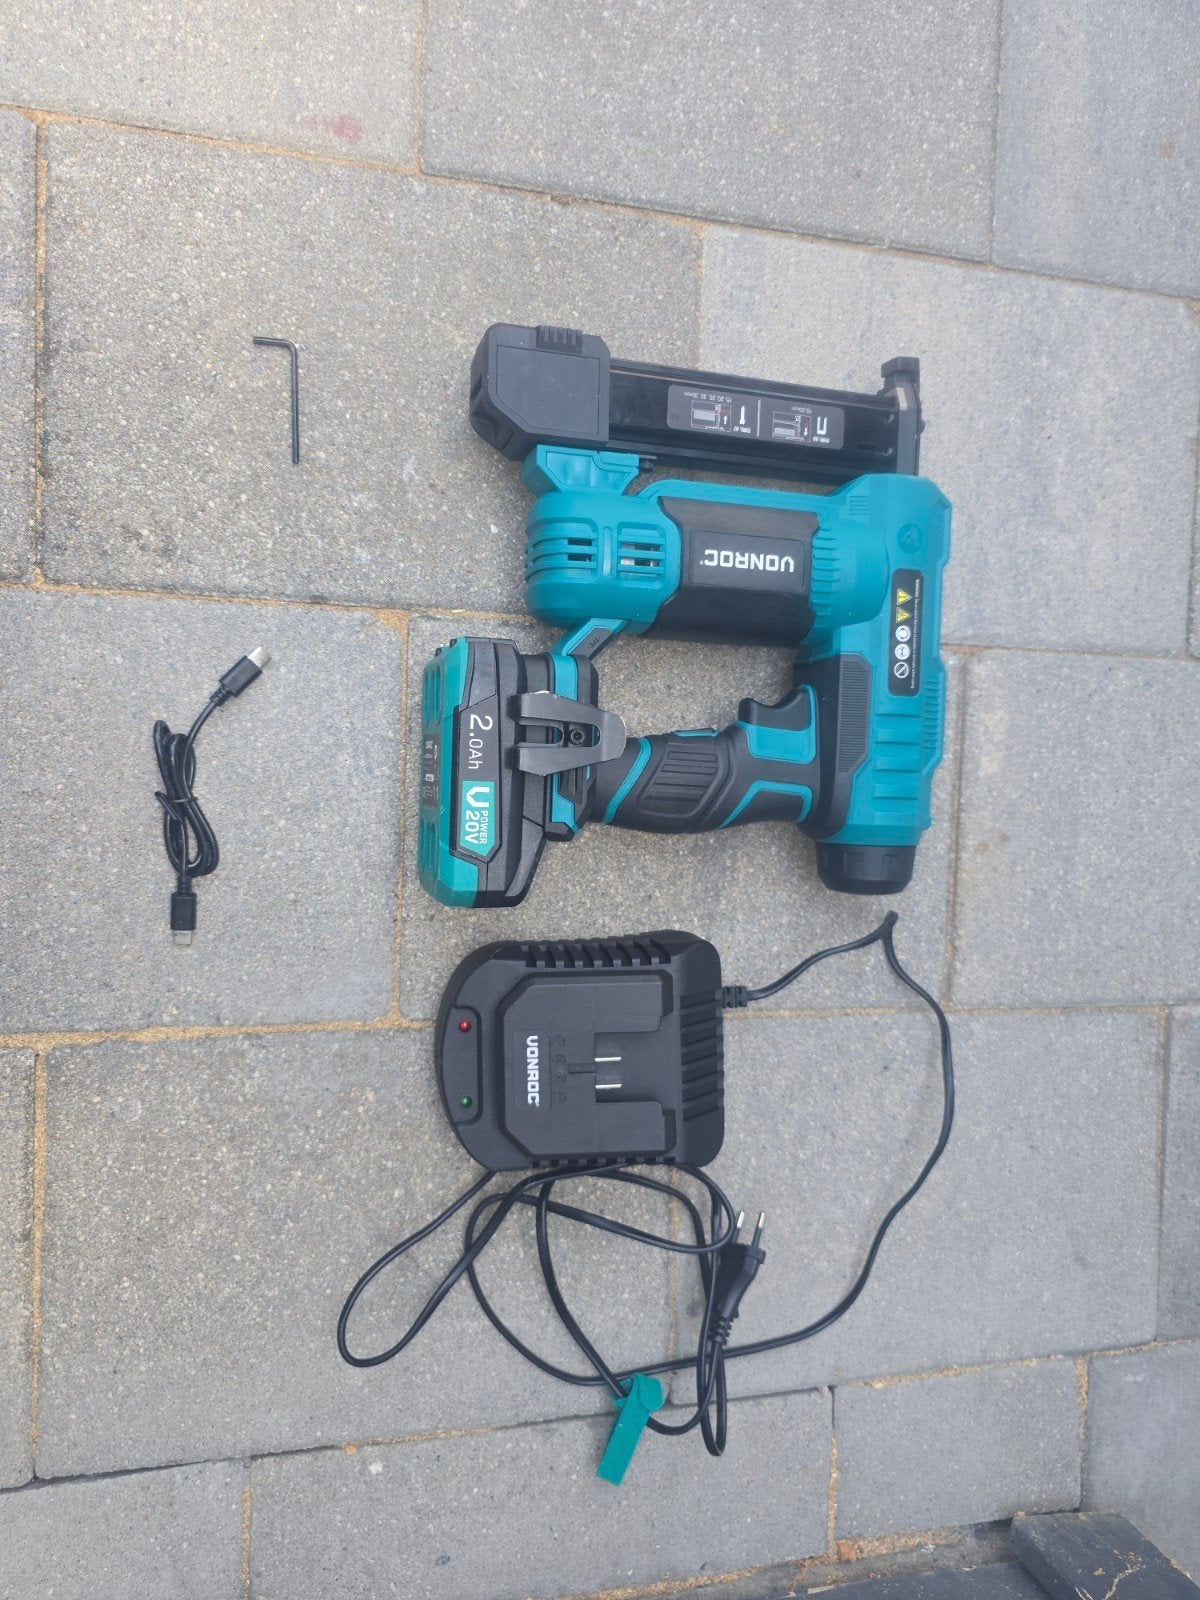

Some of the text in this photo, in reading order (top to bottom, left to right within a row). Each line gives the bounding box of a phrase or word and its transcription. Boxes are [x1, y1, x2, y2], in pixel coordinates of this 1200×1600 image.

[704, 549, 795, 573] VONROC
[468, 714, 493, 770] 2.0Ah
[464, 810, 480, 845] 20V
[479, 810, 489, 845] POWER
[526, 1035, 540, 1107] VONROC
